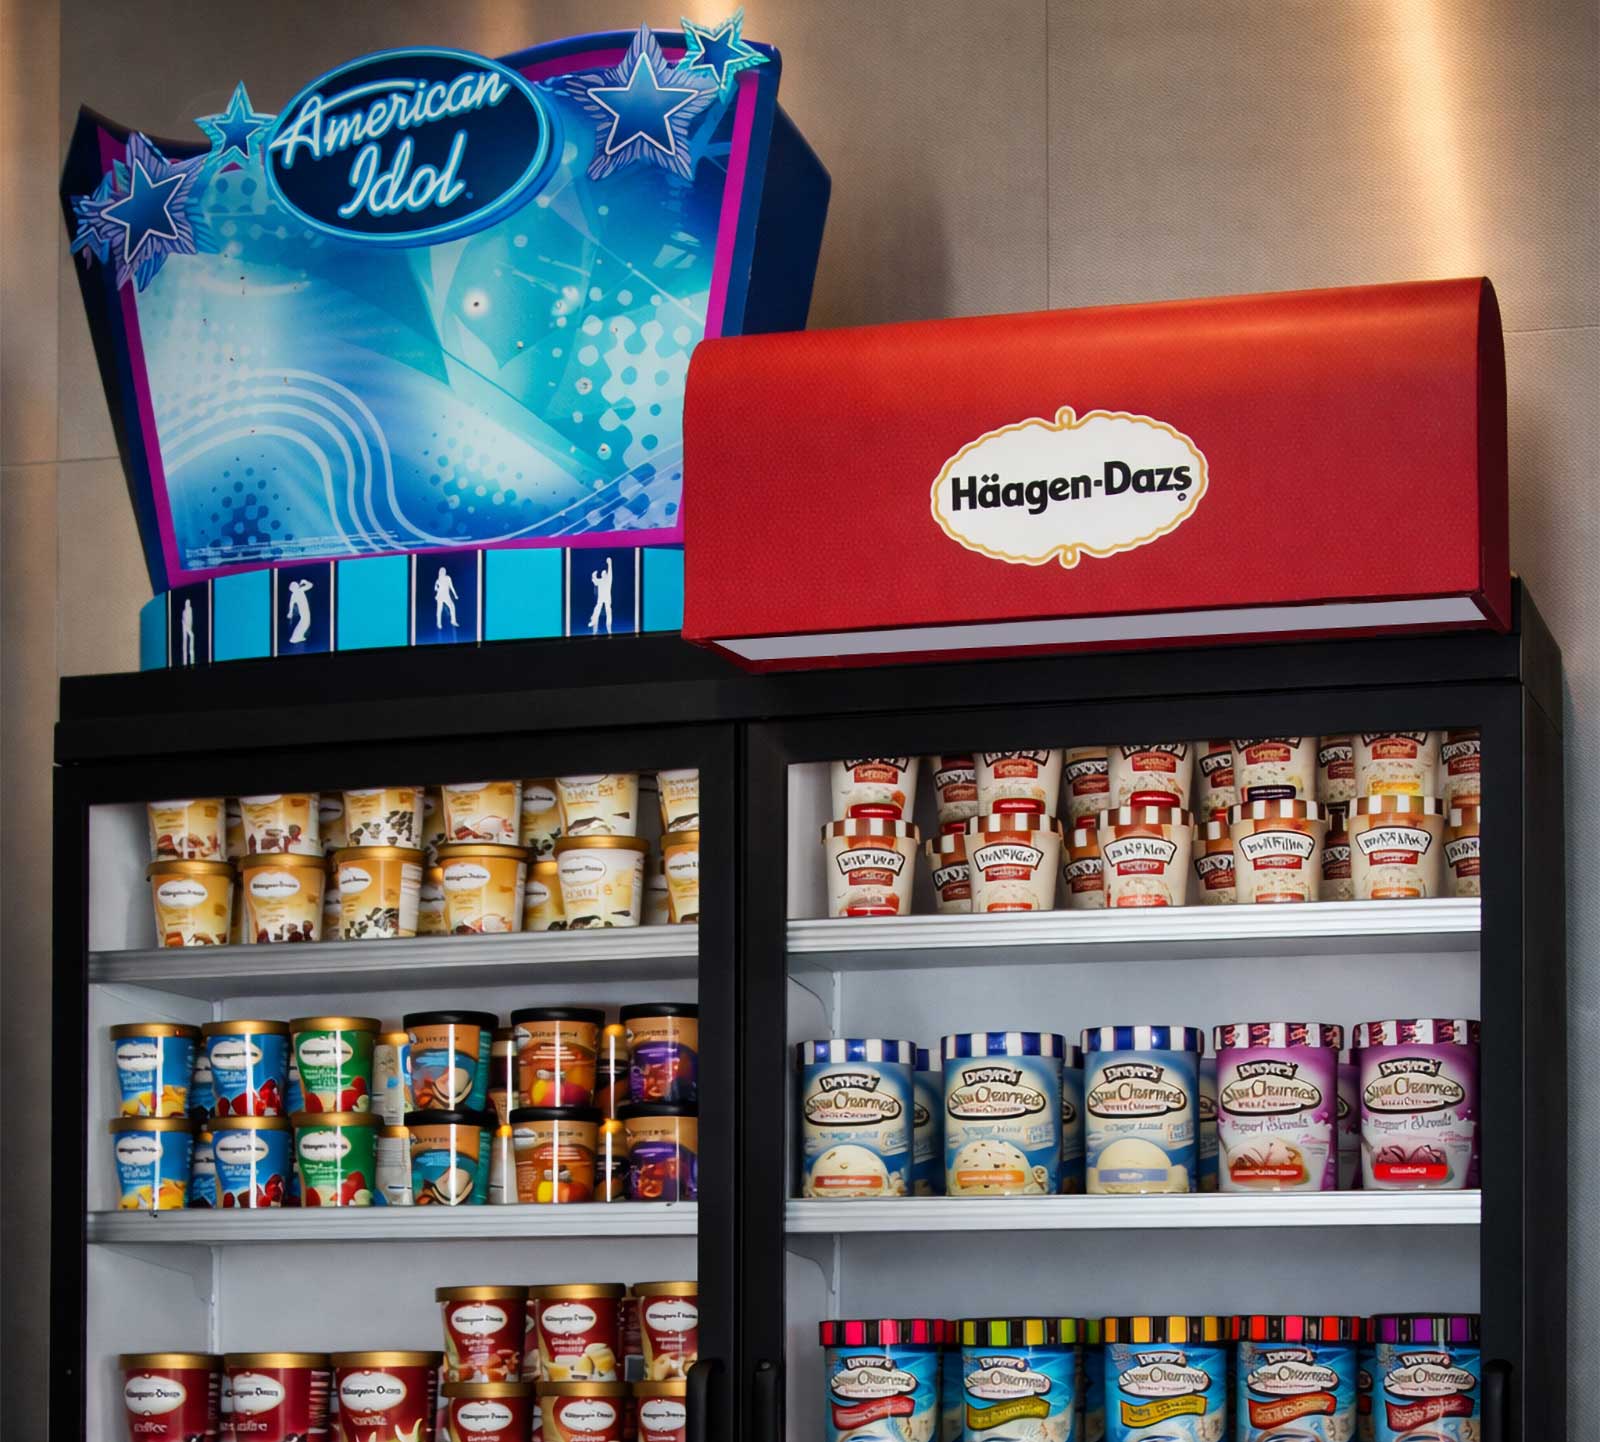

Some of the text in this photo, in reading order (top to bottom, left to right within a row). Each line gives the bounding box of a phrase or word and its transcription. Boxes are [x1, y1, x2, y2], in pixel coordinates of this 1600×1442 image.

[269, 72, 509, 166] American
[339, 131, 466, 216] Idol
[951, 460, 1192, 515] Häagen-Dazs
